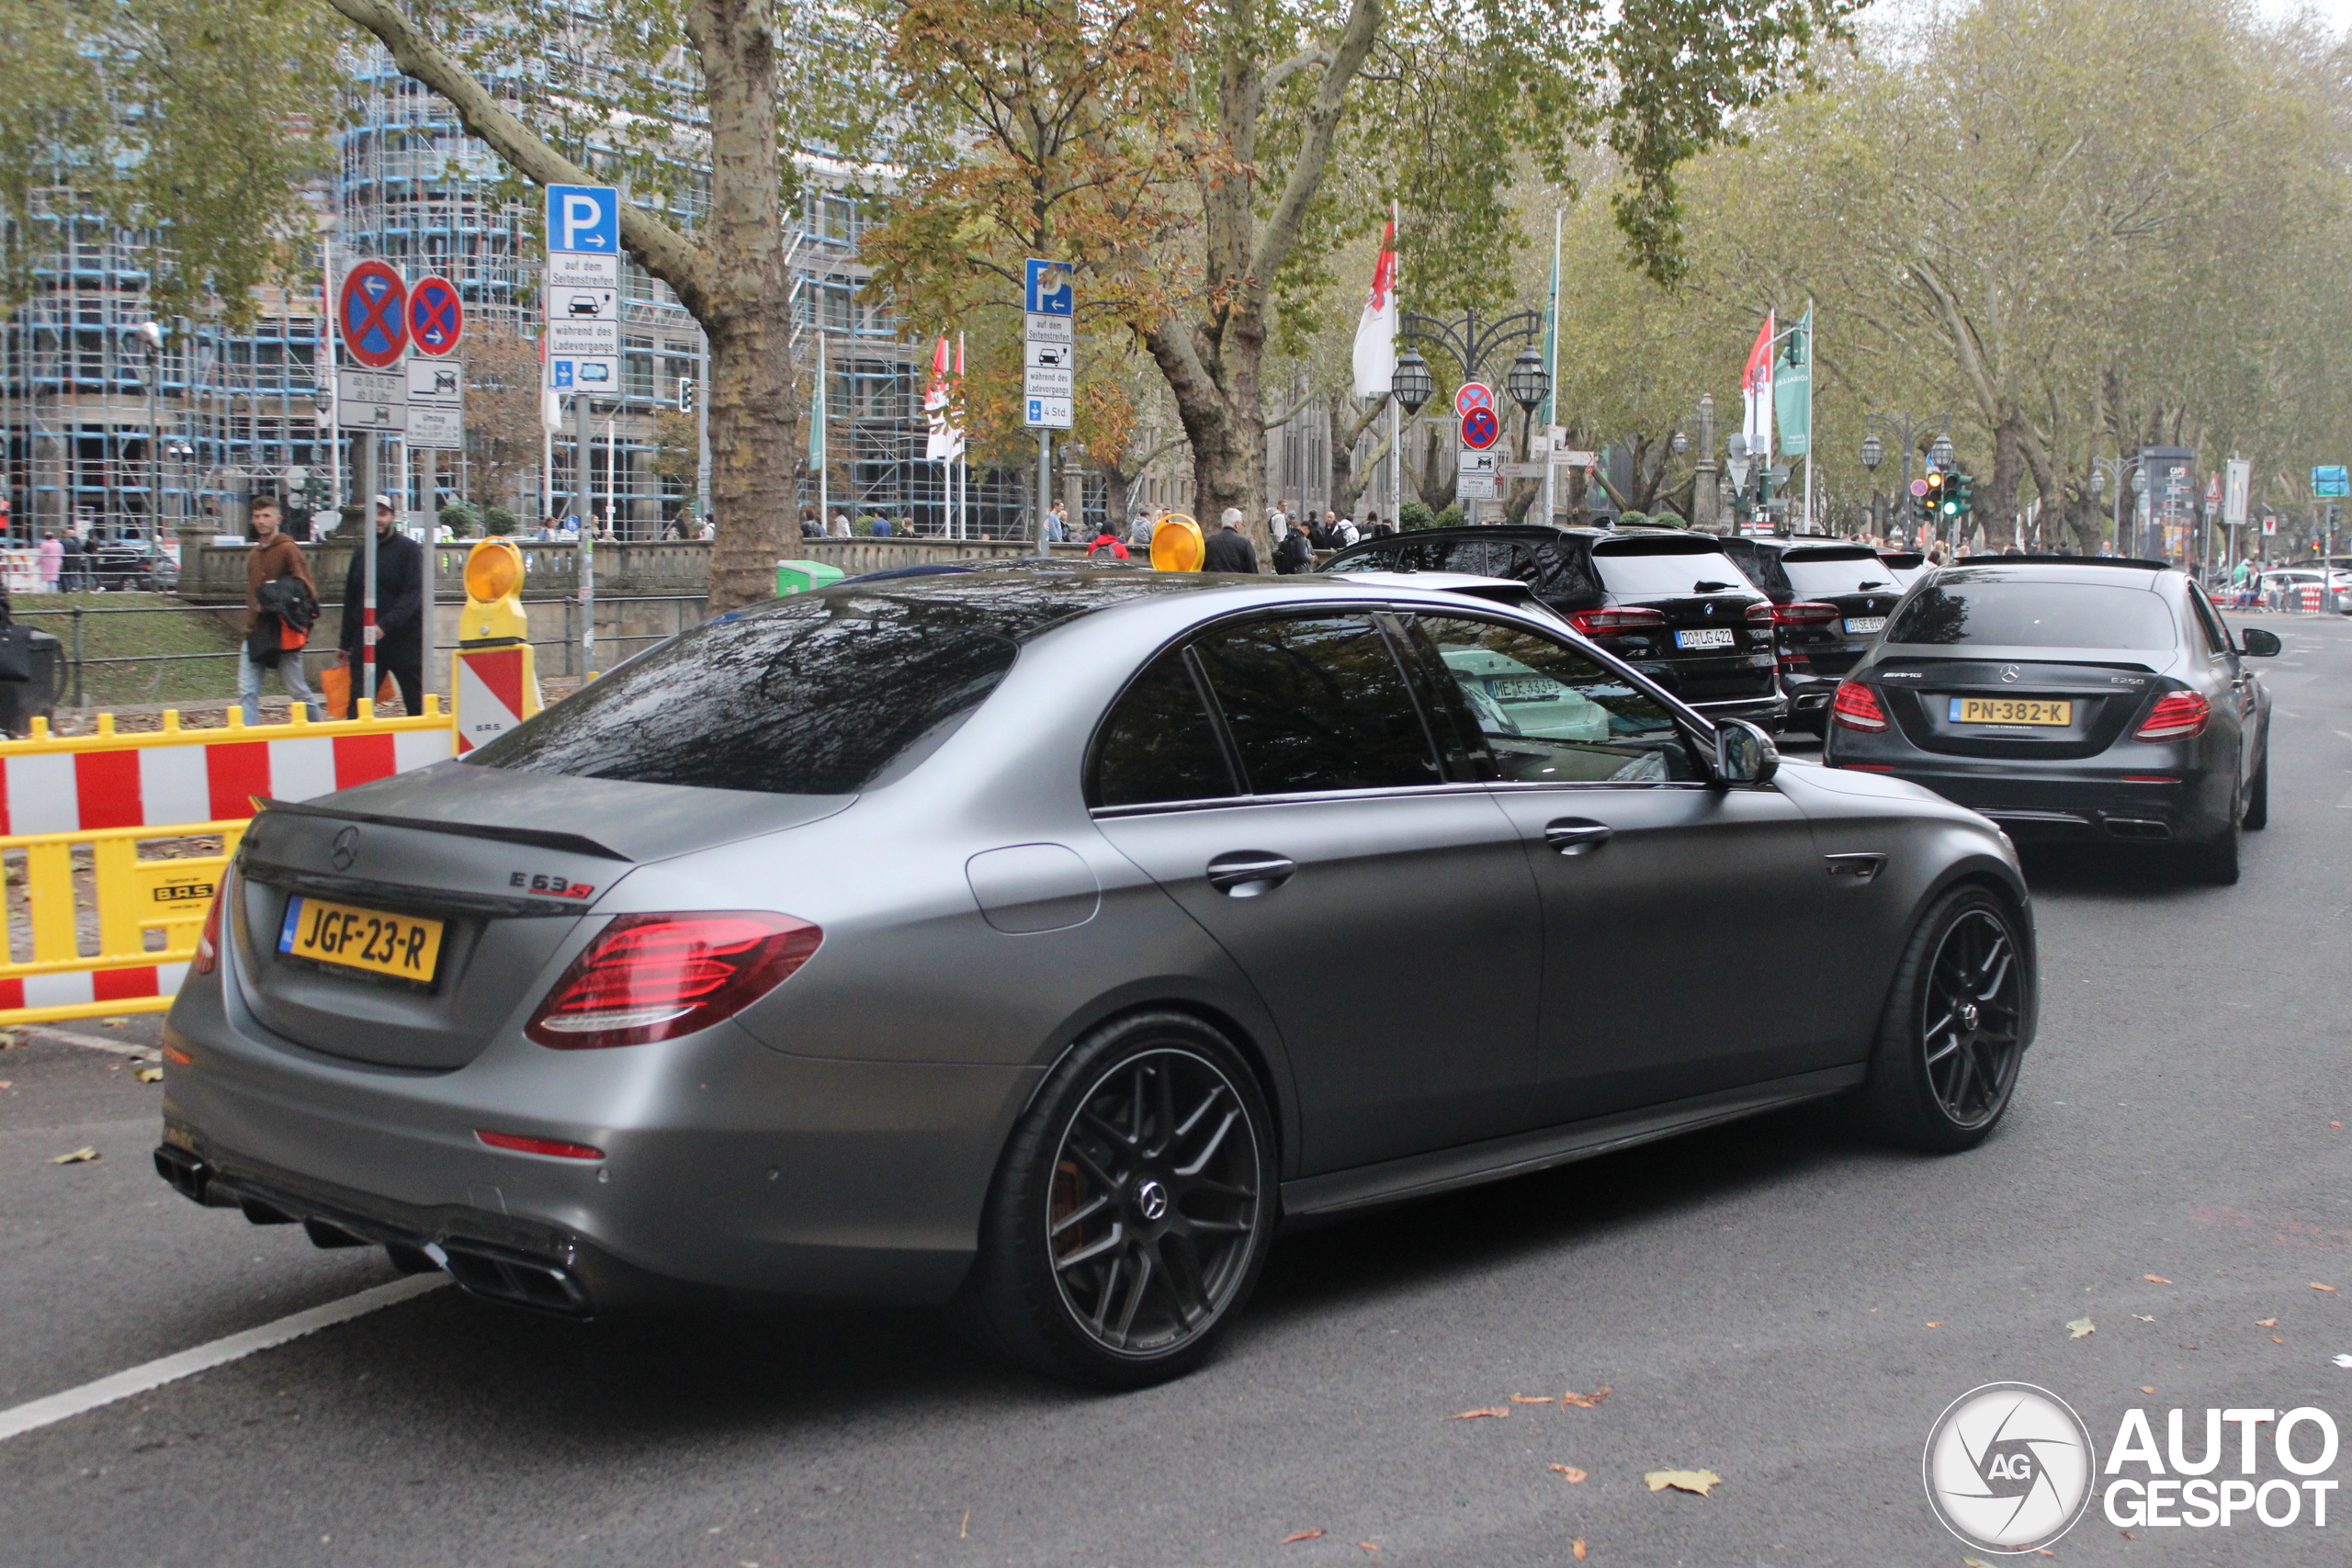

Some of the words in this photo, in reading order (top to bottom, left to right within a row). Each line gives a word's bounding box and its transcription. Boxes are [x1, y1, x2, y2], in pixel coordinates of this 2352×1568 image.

[562, 194, 602, 250] P
[564, 260, 580, 271] auf
[583, 260, 603, 272] dem
[553, 272, 615, 286] Seitenstreifen
[1036, 266, 1062, 311] P
[555, 324, 594, 336] während
[596, 325, 613, 336] des
[1036, 321, 1047, 329] auf
[1049, 321, 1062, 330] dem
[1028, 330, 1070, 342] Seitenstreifen
[553, 339, 615, 355] Ladevorgangs
[1029, 371, 1056, 382] während
[1057, 372, 1069, 383] des
[1028, 382, 1069, 396] Ladevorgangs
[1044, 406, 1049, 416] 4
[1052, 407, 1068, 418] Std.
[1849, 620, 1856, 630] D
[1859, 619, 1869, 629] SE
[1681, 632, 1694, 645] DO
[1700, 631, 1713, 644] LG
[1714, 630, 1732, 643] 422
[1494, 681, 1511, 696] ME
[1968, 702, 2062, 721] PN-382-K
[476, 723, 503, 732] B.A.S.
[156, 885, 213, 900] B.A.S.
[283, 929, 293, 942] NL
[304, 908, 426, 971] JGF-23-R
